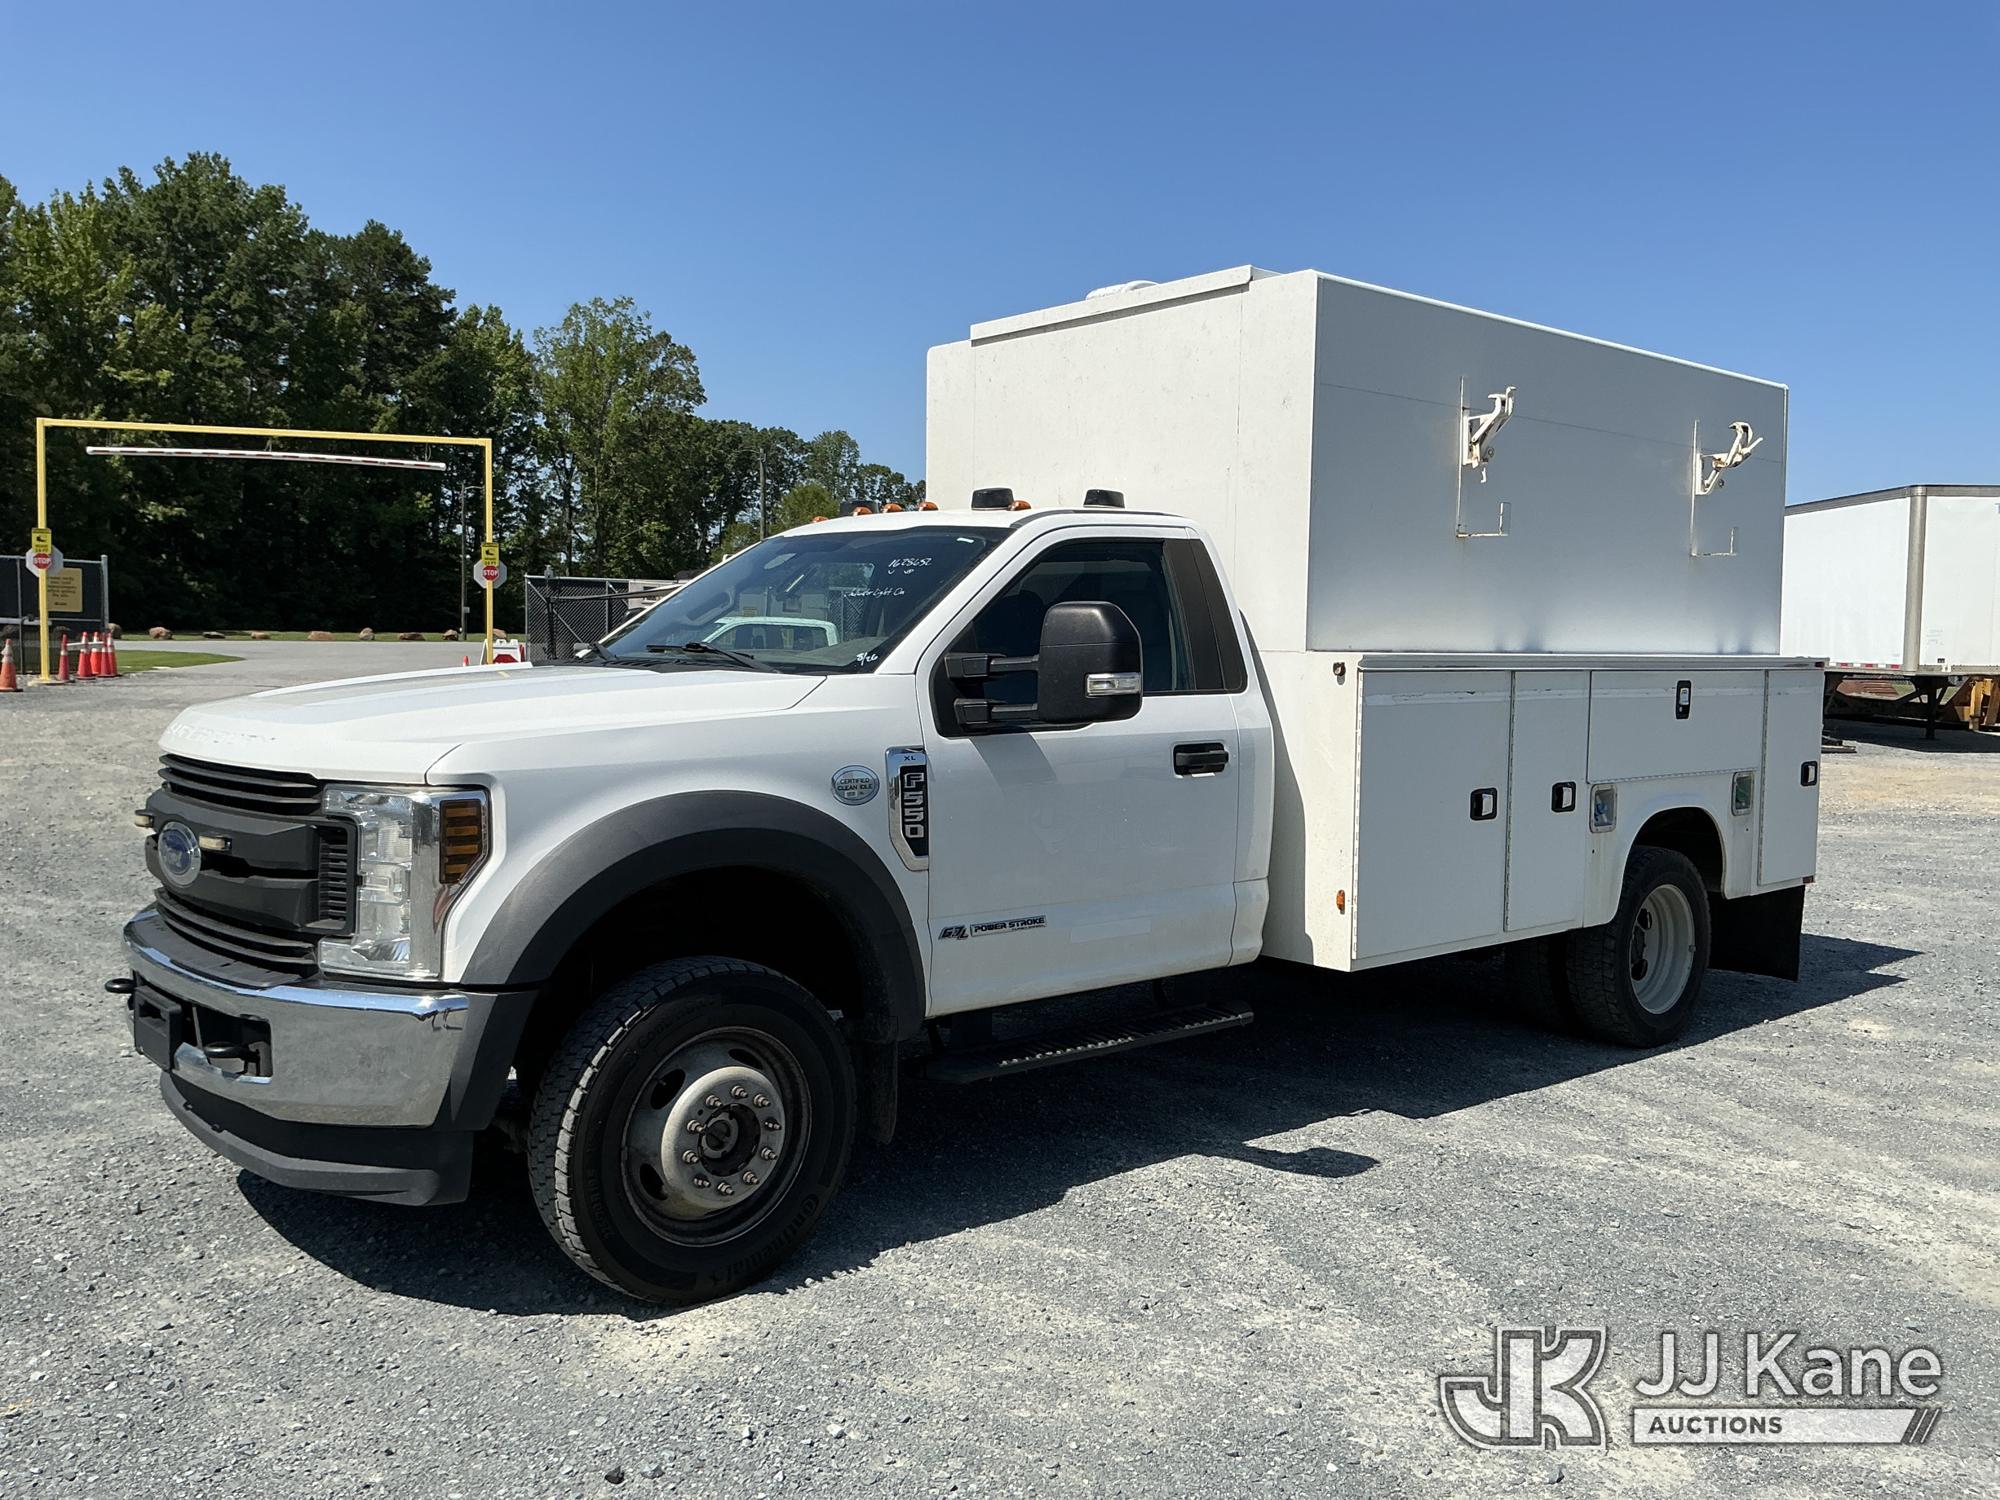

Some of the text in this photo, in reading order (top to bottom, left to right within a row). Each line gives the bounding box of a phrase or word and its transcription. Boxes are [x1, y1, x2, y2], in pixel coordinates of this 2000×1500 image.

[840, 777, 870, 785] CERTIFIED
[973, 921, 1008, 933] POWER
[1008, 917, 1046, 928] STROKE
